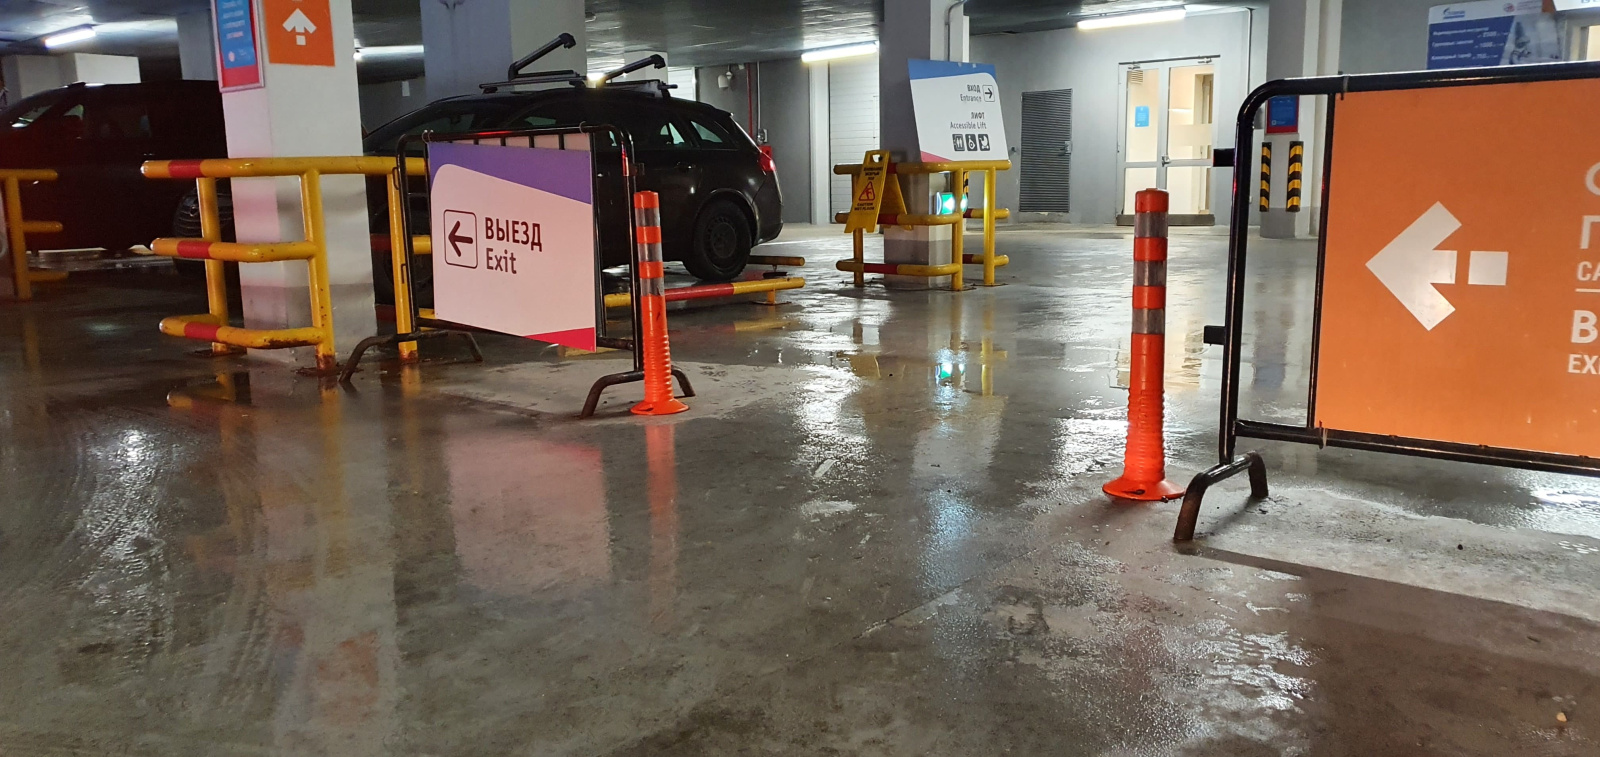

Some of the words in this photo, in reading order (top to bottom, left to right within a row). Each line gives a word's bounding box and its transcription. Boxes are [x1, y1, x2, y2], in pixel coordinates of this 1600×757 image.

[967, 84, 981, 93] ВХОД
[960, 93, 982, 102] Entrance
[971, 111, 985, 119] ЛИФТ
[950, 121, 976, 129] Accessible
[977, 121, 987, 129] Lift
[485, 217, 543, 252] ВЫЕЗД
[486, 247, 517, 274] Exit
